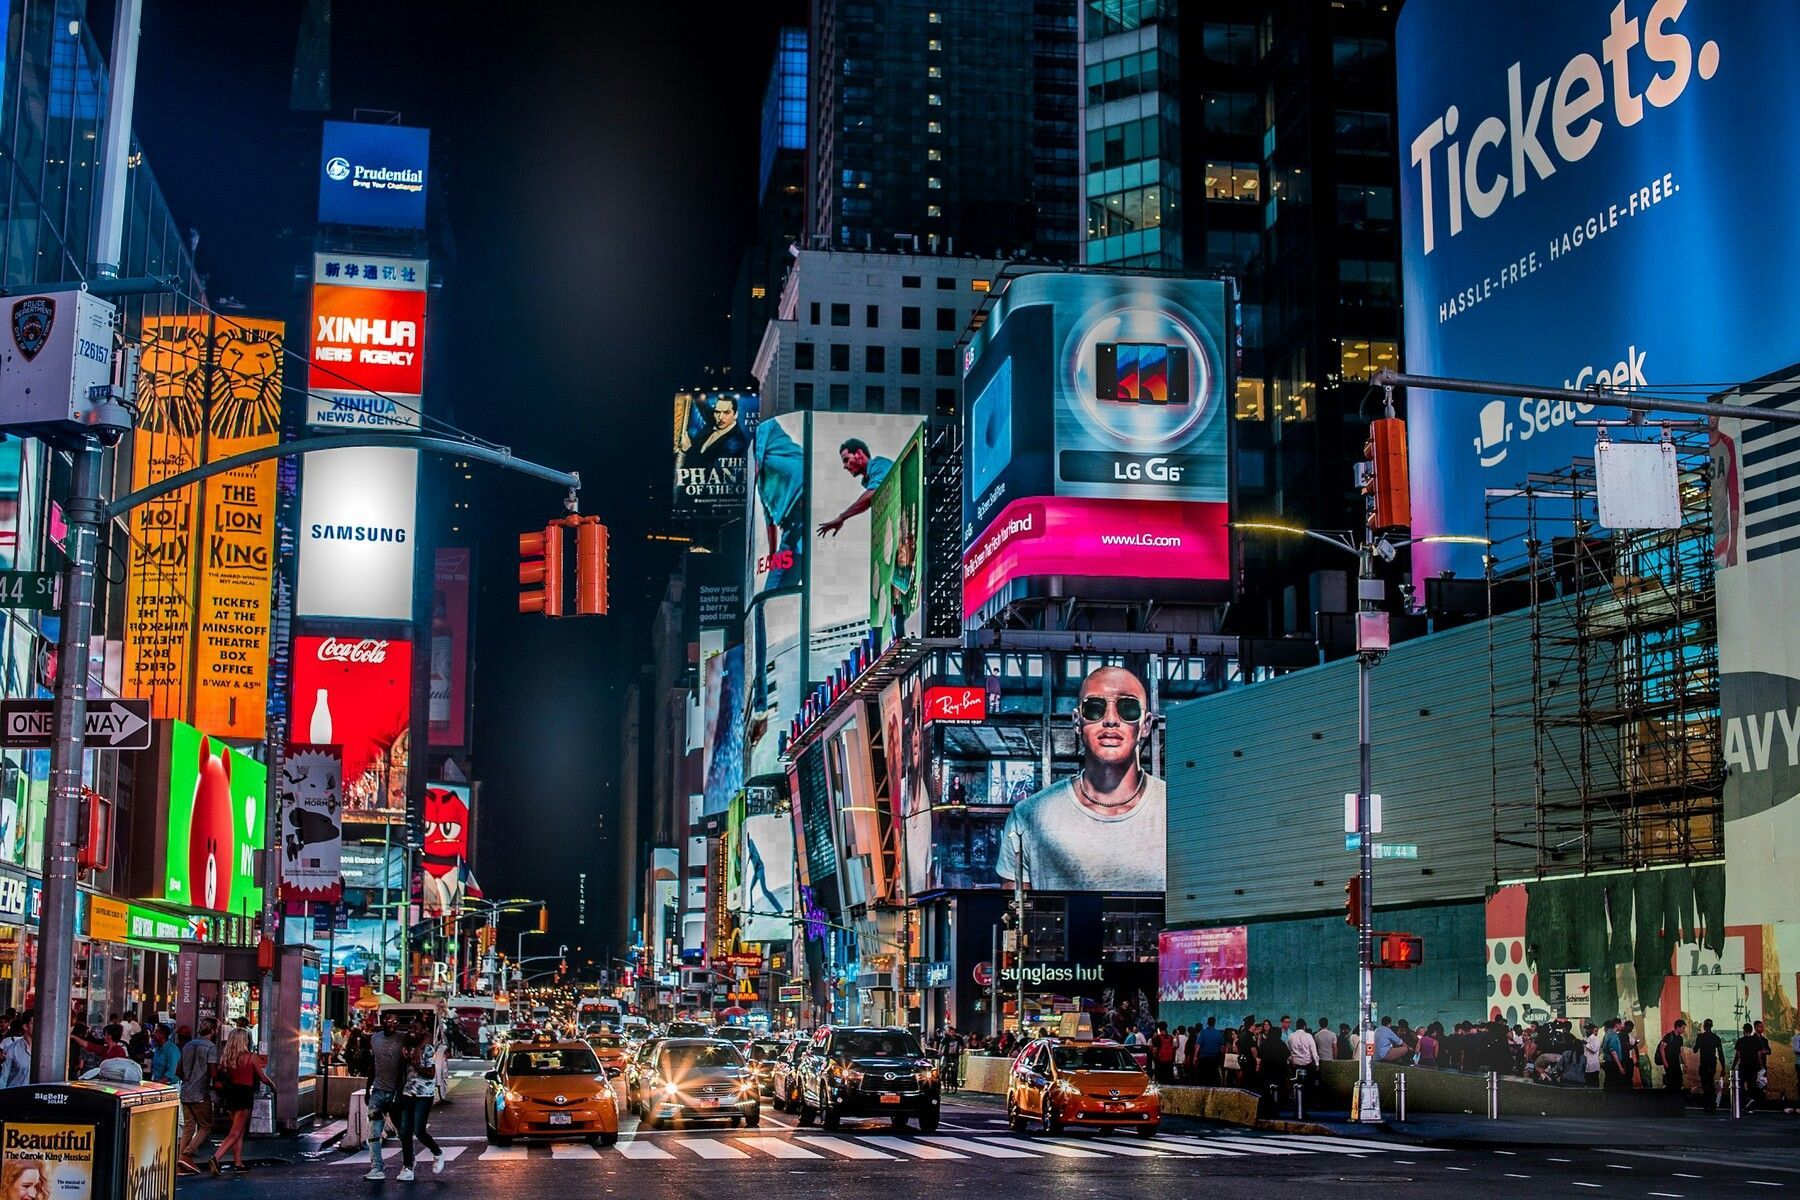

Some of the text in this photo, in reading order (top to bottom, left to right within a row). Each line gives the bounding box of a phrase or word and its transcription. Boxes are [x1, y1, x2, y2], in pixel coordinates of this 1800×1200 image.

[1411, 0, 1720, 255] Tickets.
[354, 165, 422, 183] Prudential
[353, 180, 371, 189] Bring
[372, 181, 386, 189] Your
[1439, 172, 1681, 324] HASSLE-FREE. HAGGLE-FREE.
[325, 262, 416, 283] 新华通讯社
[23, 300, 46, 309] POLICE
[14, 308, 52, 320] DEPARTMENT
[317, 315, 416, 347] XINHUA
[315, 346, 415, 366] NEWS AGENCY
[1519, 345, 1648, 441] SeatGeek
[331, 396, 397, 414] XINHUA
[317, 411, 411, 428] NEWS AGENCY
[718, 457, 746, 468] THE
[1114, 462, 1140, 480] LG
[222, 484, 256, 502] THE
[685, 485, 704, 496] OF
[706, 486, 734, 495] THE
[215, 504, 262, 532] LION
[311, 523, 406, 544] SAMSUNG
[1101, 533, 1181, 547] www.LG.com
[209, 535, 268, 569] KING
[36, 577, 53, 594] St
[700, 585, 738, 595] Show your
[212, 597, 259, 609] TICKETS
[700, 594, 738, 603] taste buds
[215, 611, 256, 622] AT THE
[705, 603, 728, 613] berry
[700, 612, 736, 623] good time
[202, 623, 267, 636] MINSKOFF
[208, 637, 260, 649] THEATRE
[317, 637, 390, 663] Coca-Cola
[220, 651, 246, 661] BOX
[212, 663, 253, 675] OFFICE
[203, 679, 230, 688] B'WAY
[936, 690, 981, 716] Ray-Ban
[13, 714, 129, 733] ONE WAY
[1383, 845, 1391, 857] W
[1395, 845, 1407, 857] 44
[0, 876, 27, 914] ERS
[433, 961, 452, 984] R
[1001, 963, 1105, 985] sunglass hut
[183, 960, 193, 1003] Newsstand
[34, 1092, 69, 1102] BigBelly
[6, 1129, 92, 1151] Beautiful
[5, 1151, 91, 1163] The Carole King Musical
